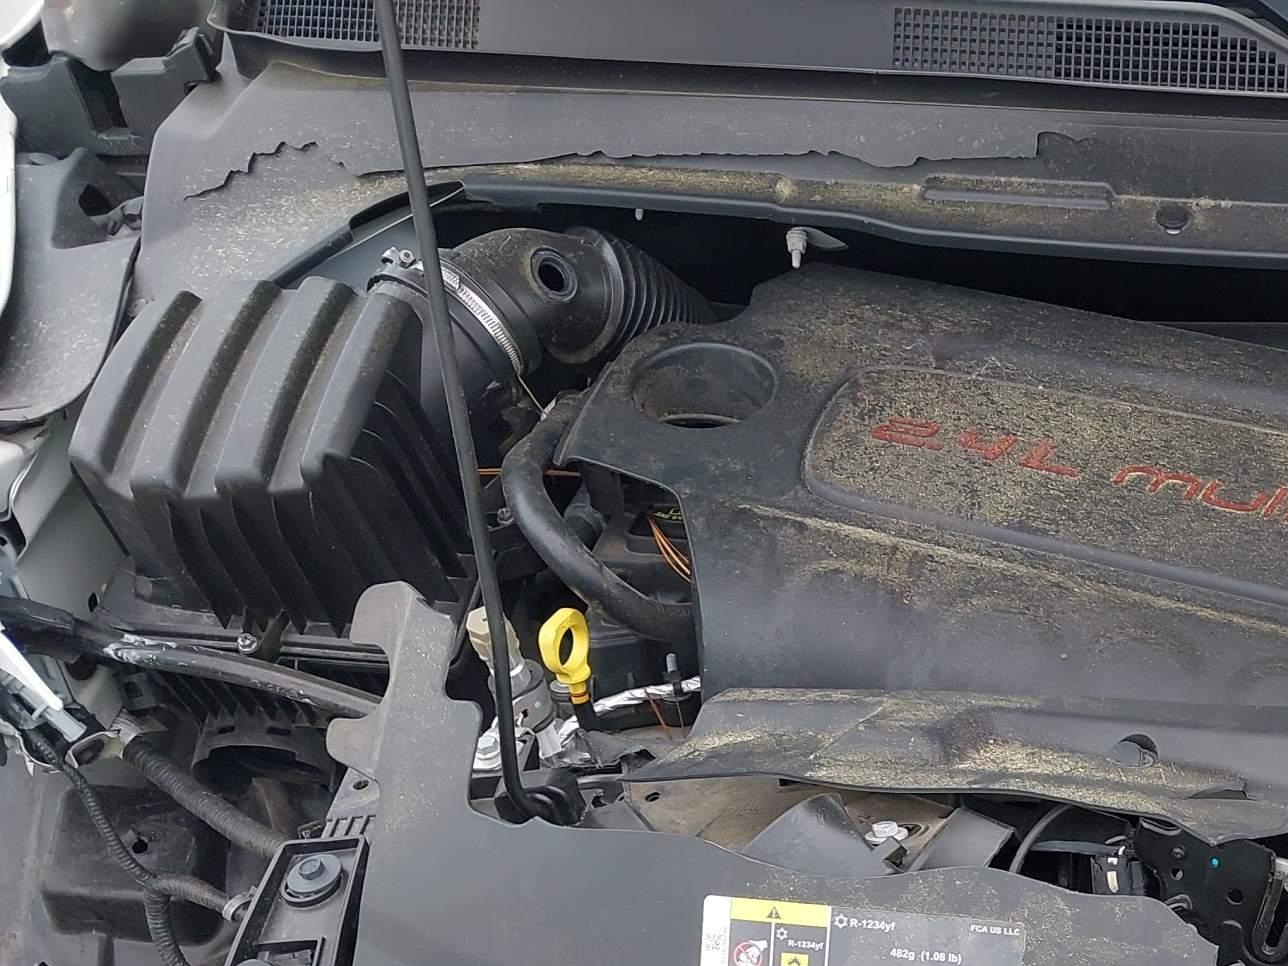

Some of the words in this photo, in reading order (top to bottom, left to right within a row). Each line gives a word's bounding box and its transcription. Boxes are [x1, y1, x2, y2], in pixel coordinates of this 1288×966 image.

[850, 919, 896, 932] R-1234yf
[970, 924, 988, 934] FCA
[989, 926, 1002, 935] US
[1003, 927, 1021, 936] LLC
[787, 939, 825, 950] R-1234yf
[889, 948, 915, 961] 482g
[920, 950, 946, 962] (1.06
[948, 952, 962, 965] lb)
